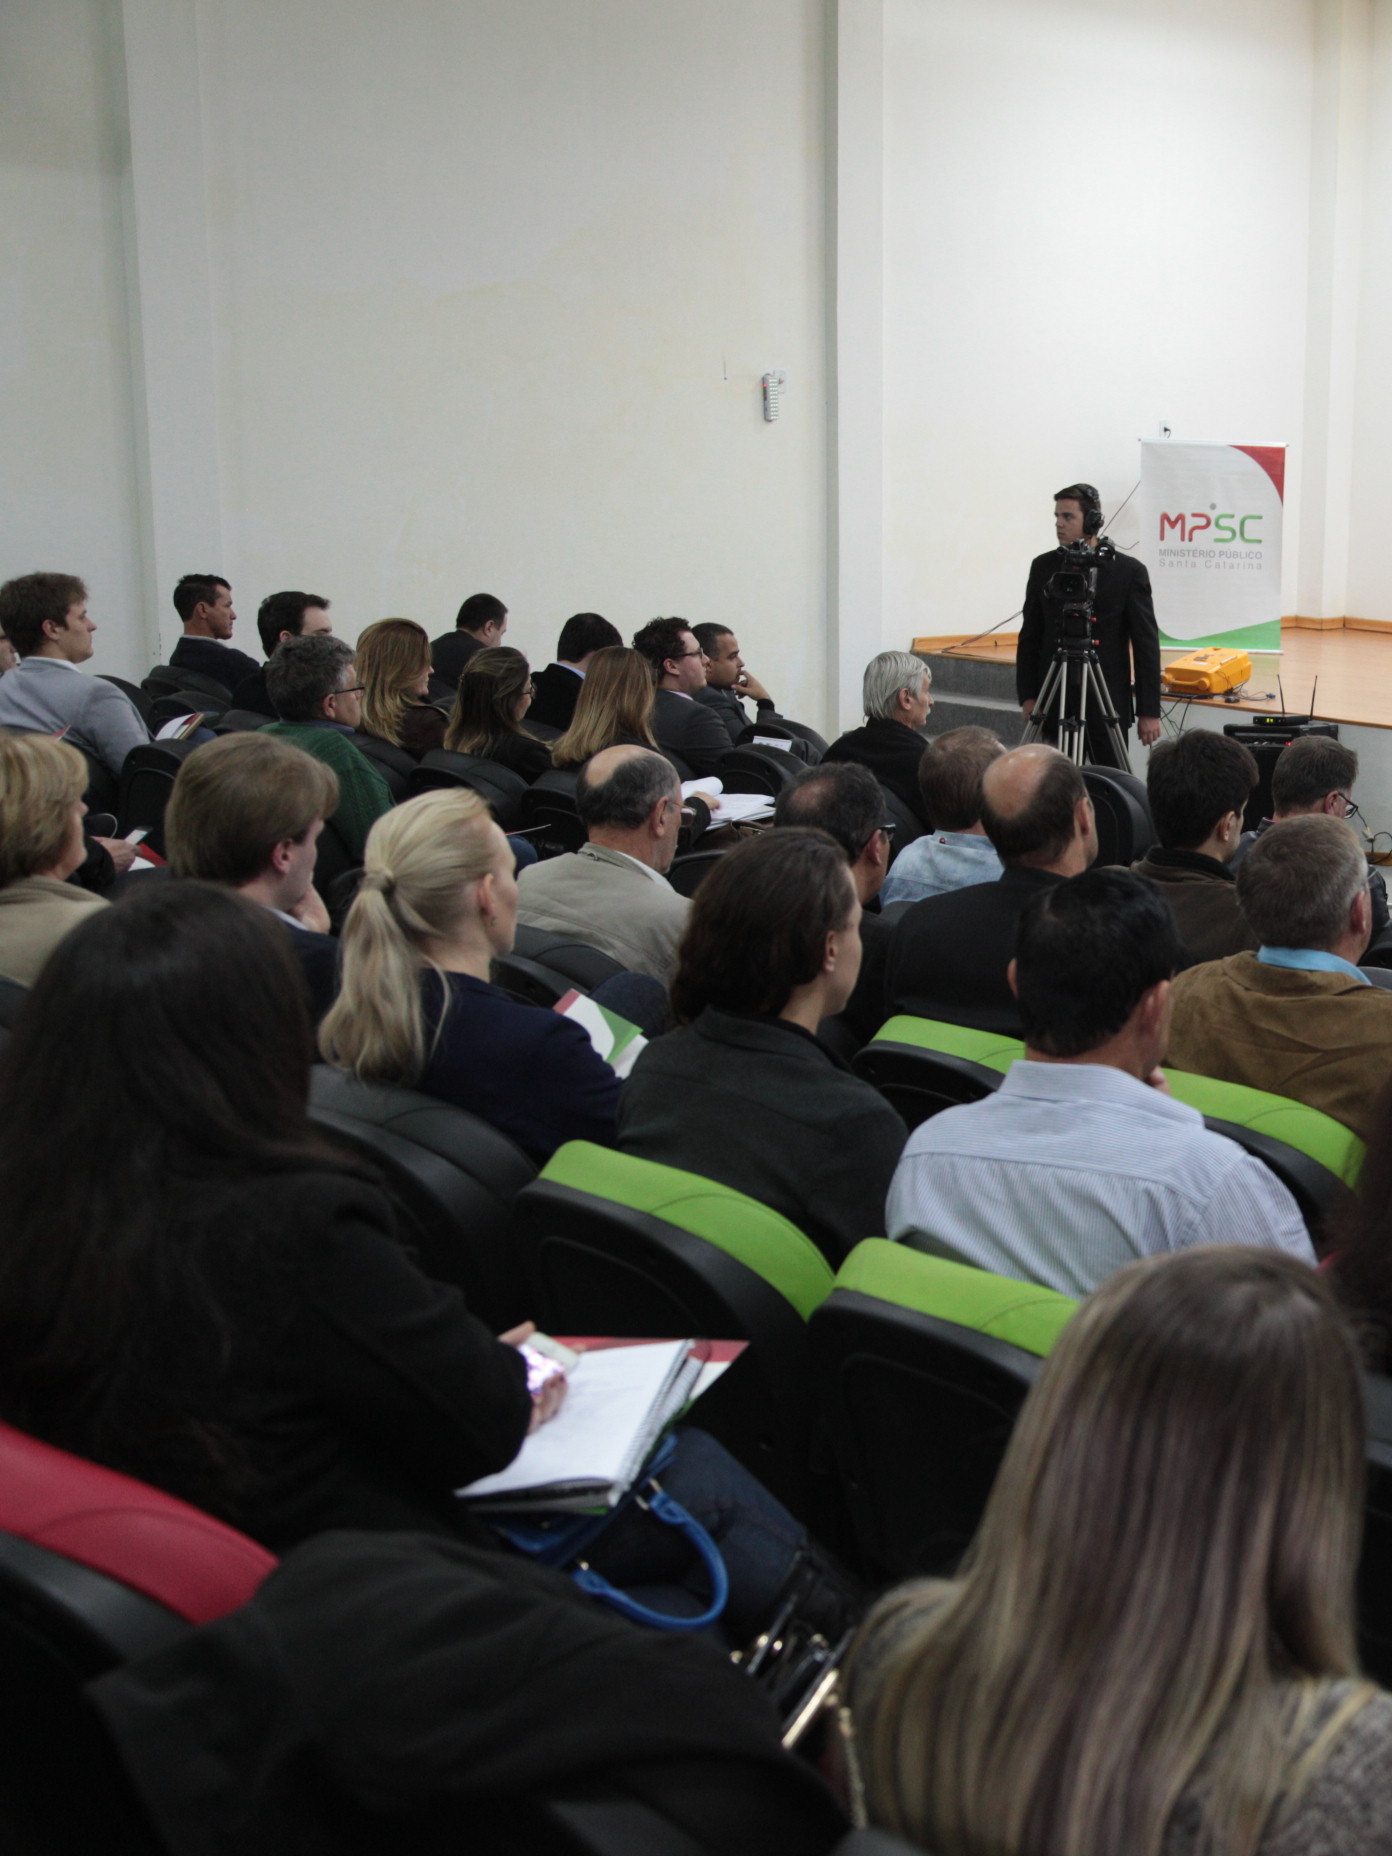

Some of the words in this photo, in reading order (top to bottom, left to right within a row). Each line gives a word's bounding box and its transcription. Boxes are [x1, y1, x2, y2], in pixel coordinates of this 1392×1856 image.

[1160, 512, 1263, 544] MPSC
[1159, 548, 1216, 559] MINISTÉRIO
[1218, 548, 1263, 560] PÚBLICO
[1159, 558, 1197, 569] Santa
[1204, 559, 1263, 570] Catarina
